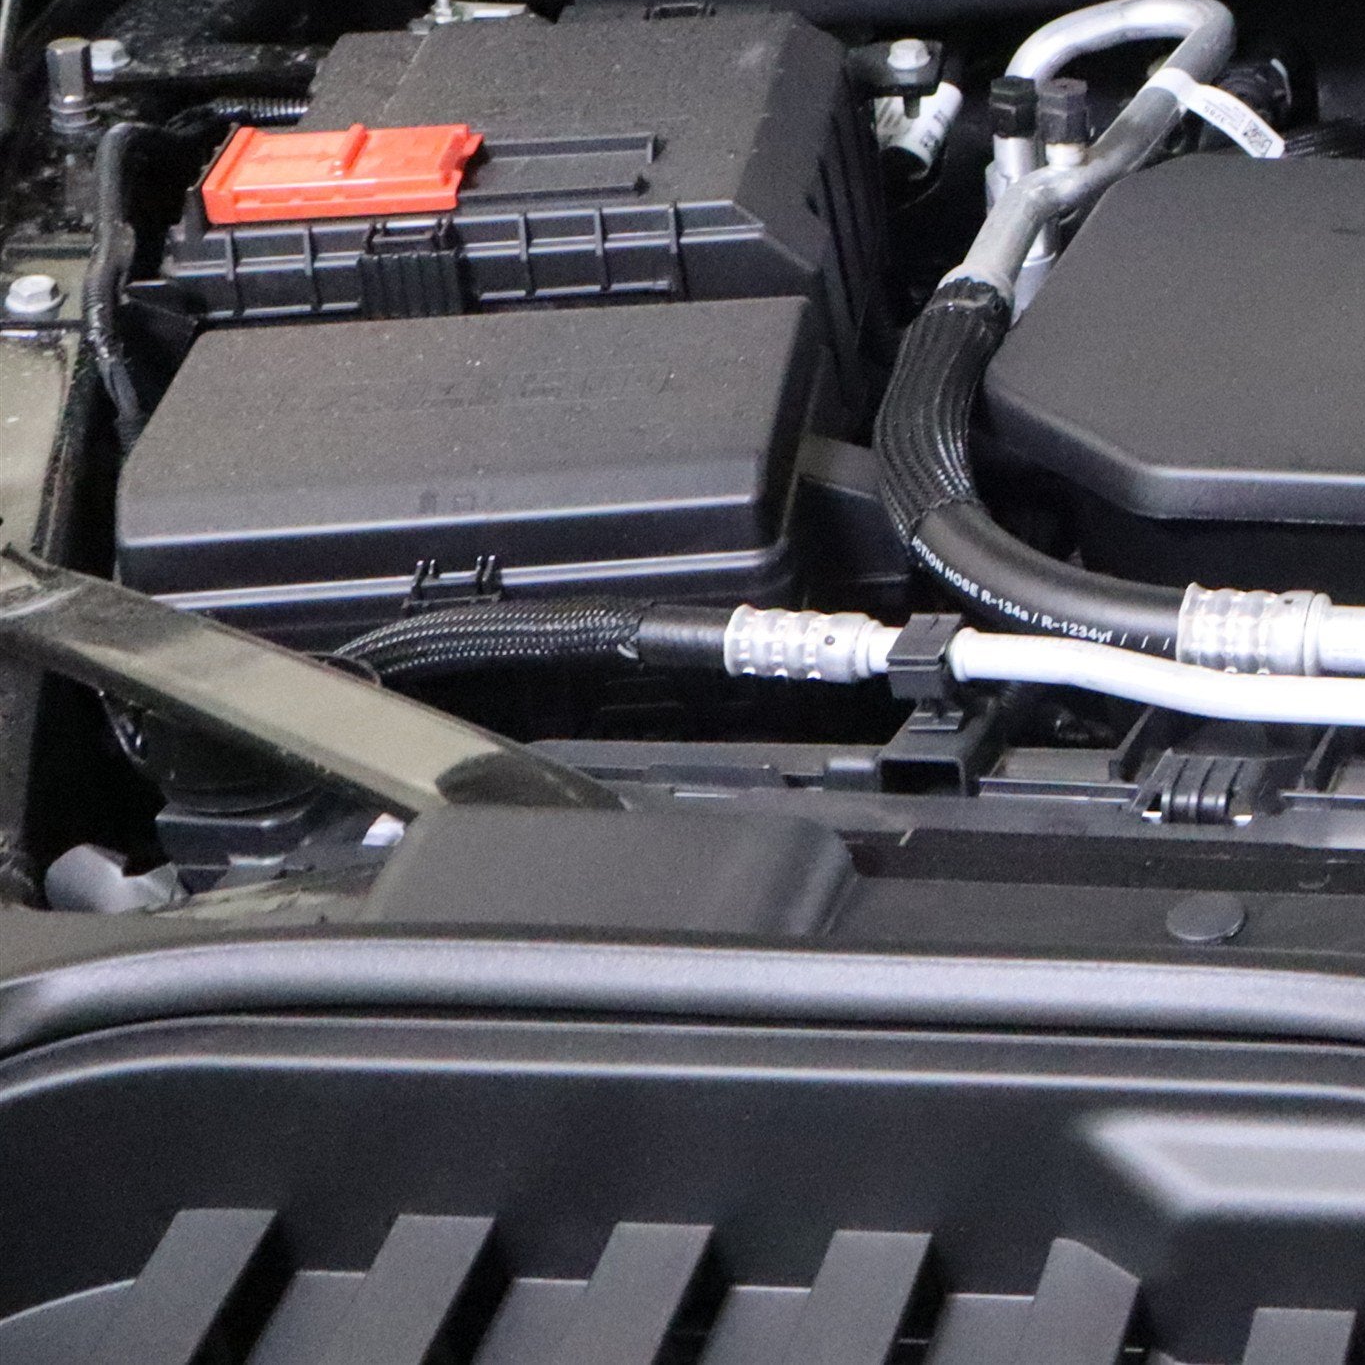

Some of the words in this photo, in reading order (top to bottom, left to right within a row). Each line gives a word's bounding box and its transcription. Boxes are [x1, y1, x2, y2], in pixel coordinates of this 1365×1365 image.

[944, 567, 979, 598] HOSE
[981, 589, 1028, 621] R-134a
[1041, 614, 1113, 644] R-1234yf
